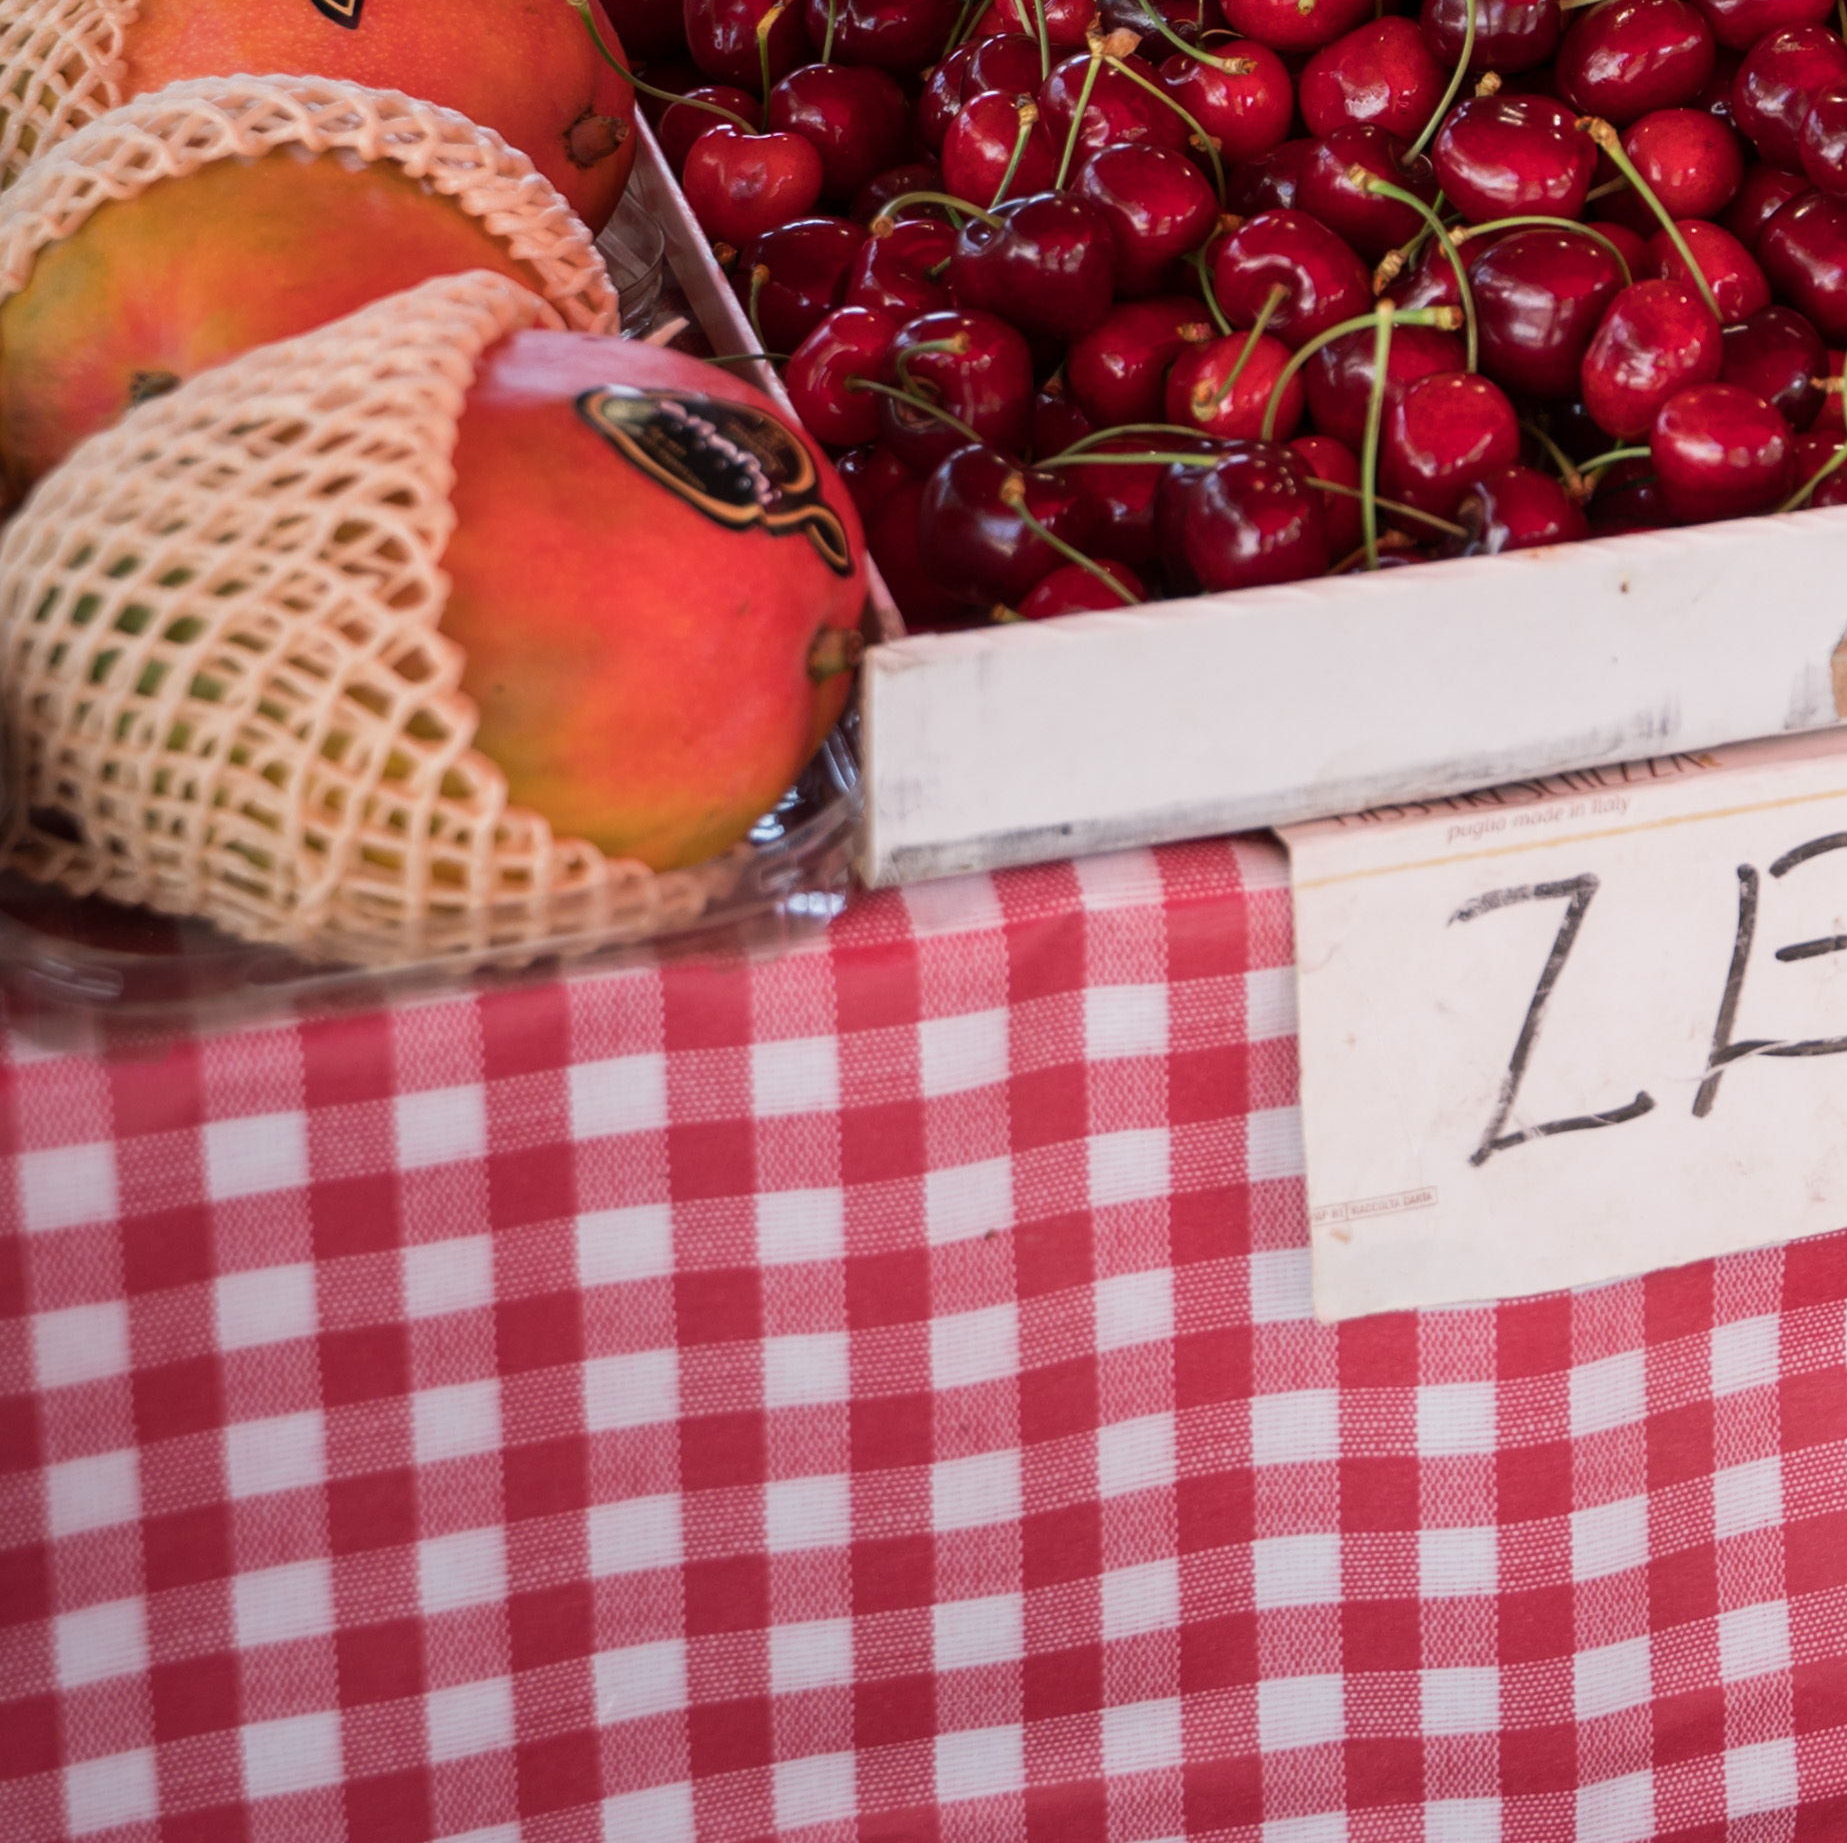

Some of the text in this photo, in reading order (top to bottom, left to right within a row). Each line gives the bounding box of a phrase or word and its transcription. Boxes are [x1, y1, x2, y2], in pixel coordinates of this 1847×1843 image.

[1446, 814, 1507, 844] puglia
[1513, 807, 1565, 828] made
[1570, 802, 1587, 819] in
